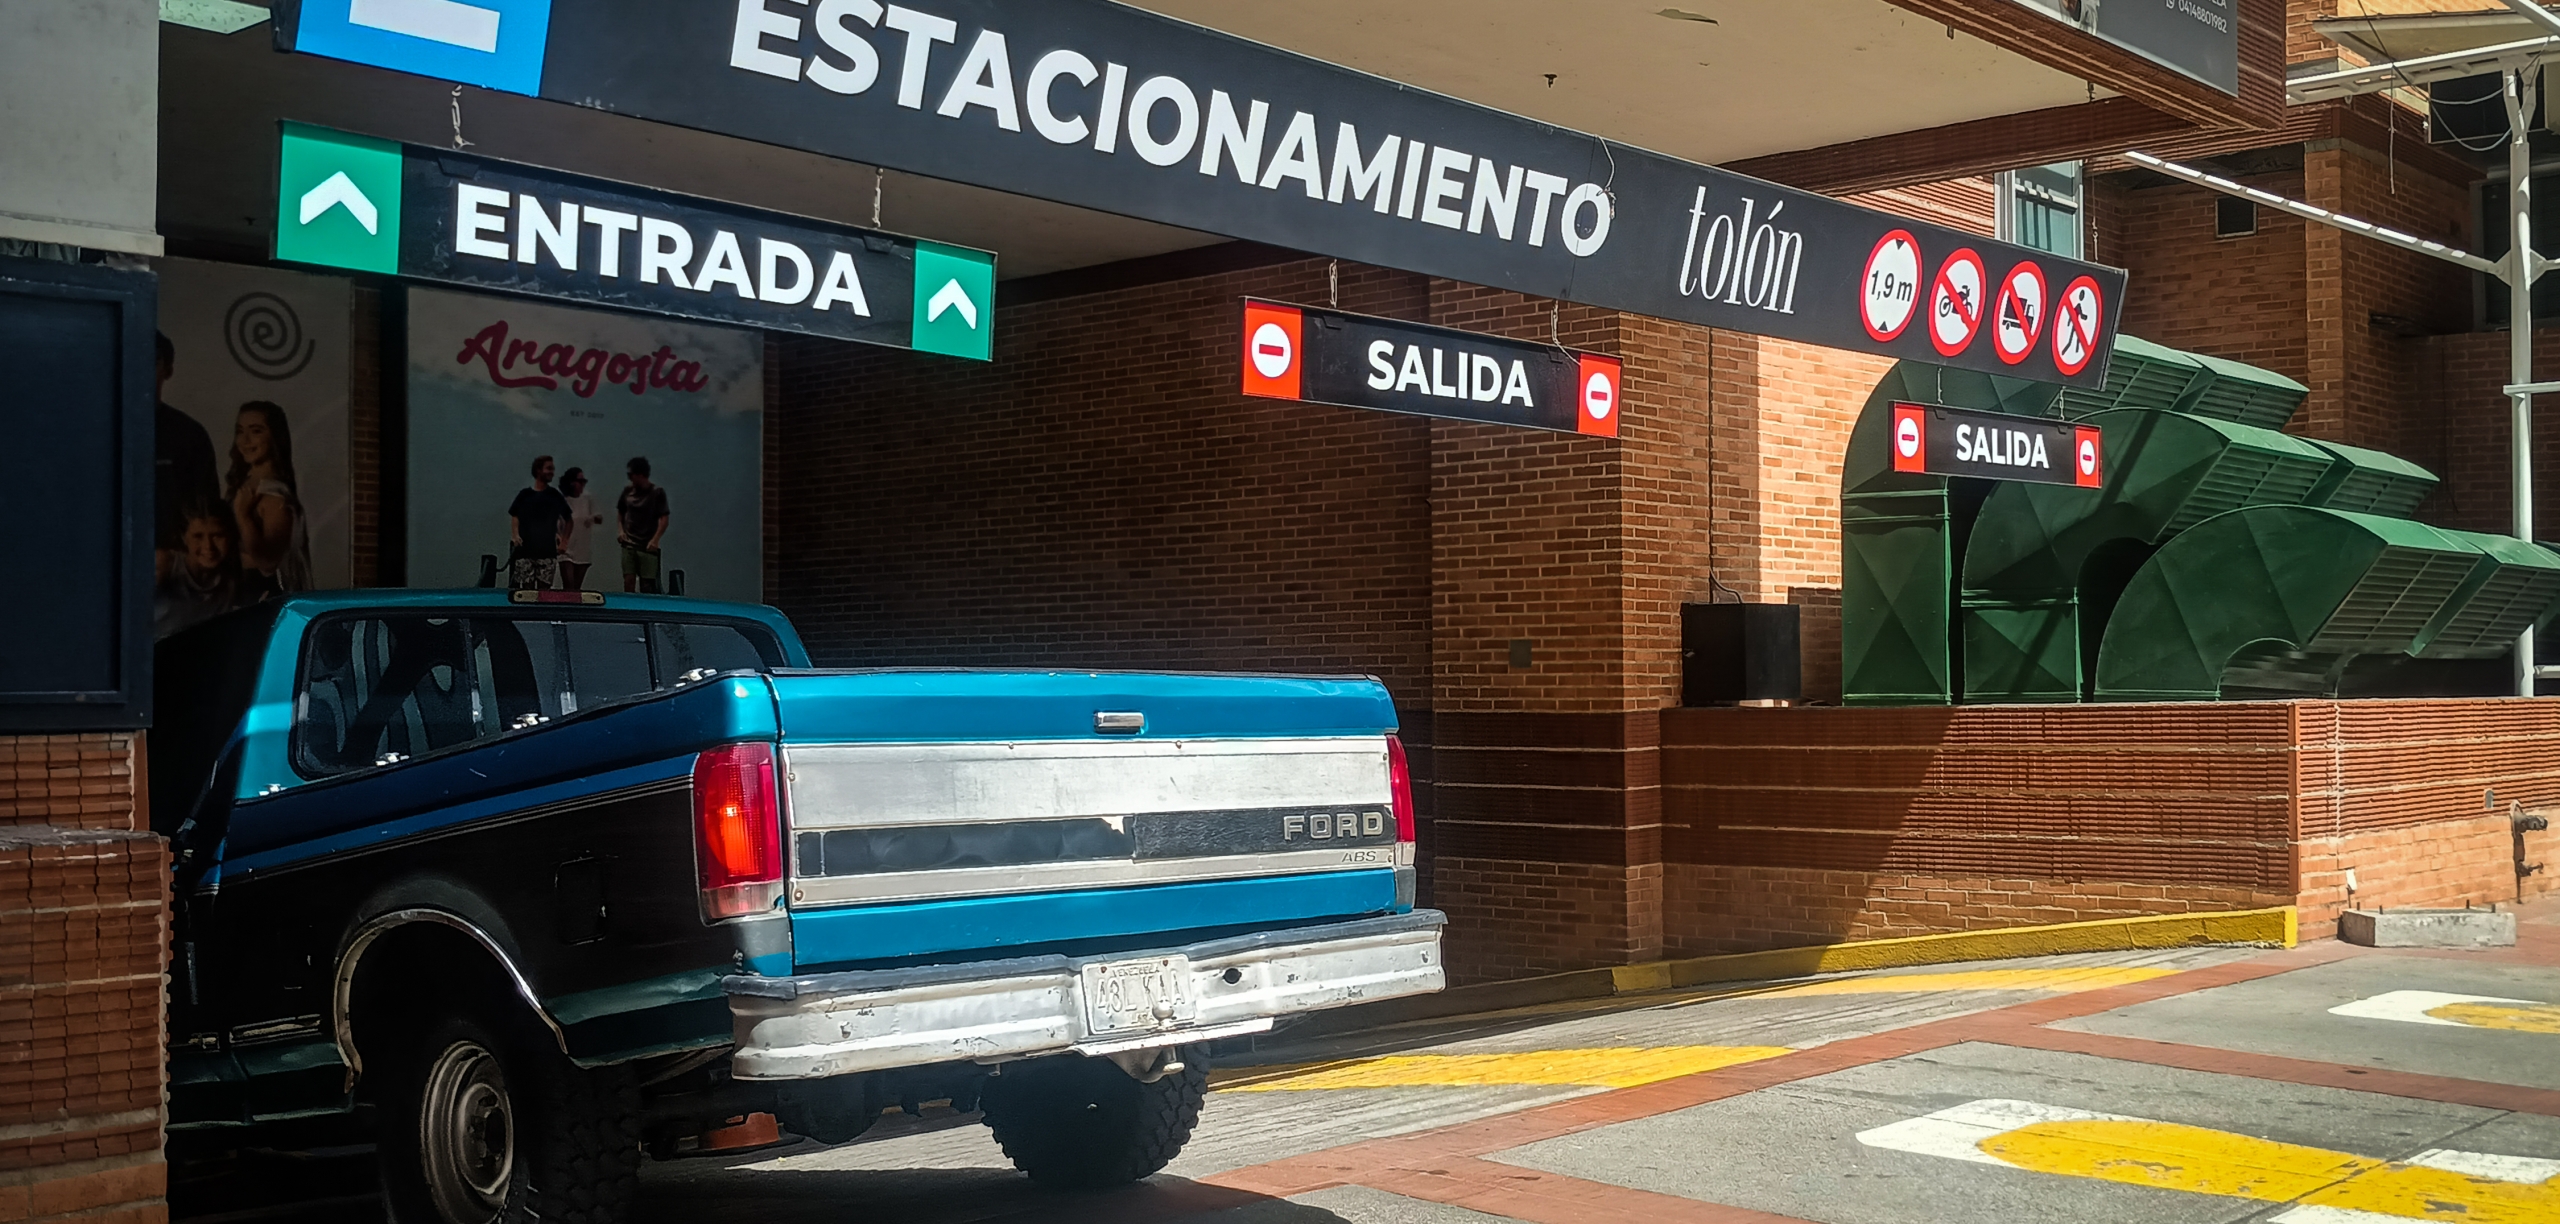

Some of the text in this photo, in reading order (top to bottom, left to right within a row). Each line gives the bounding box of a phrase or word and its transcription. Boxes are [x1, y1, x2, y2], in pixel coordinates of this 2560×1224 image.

[730, 0, 1612, 257] ESTACIONAMIENTO
[455, 183, 871, 318] ENTRADA
[1678, 185, 1804, 315] tolón
[1871, 269, 1914, 302] 1,9 m
[456, 319, 710, 399] Aragosta
[1366, 340, 1534, 408] SALIDA
[1955, 423, 2050, 470] SALIDA
[1283, 811, 1384, 841] FORD
[1341, 850, 1377, 863] ABS
